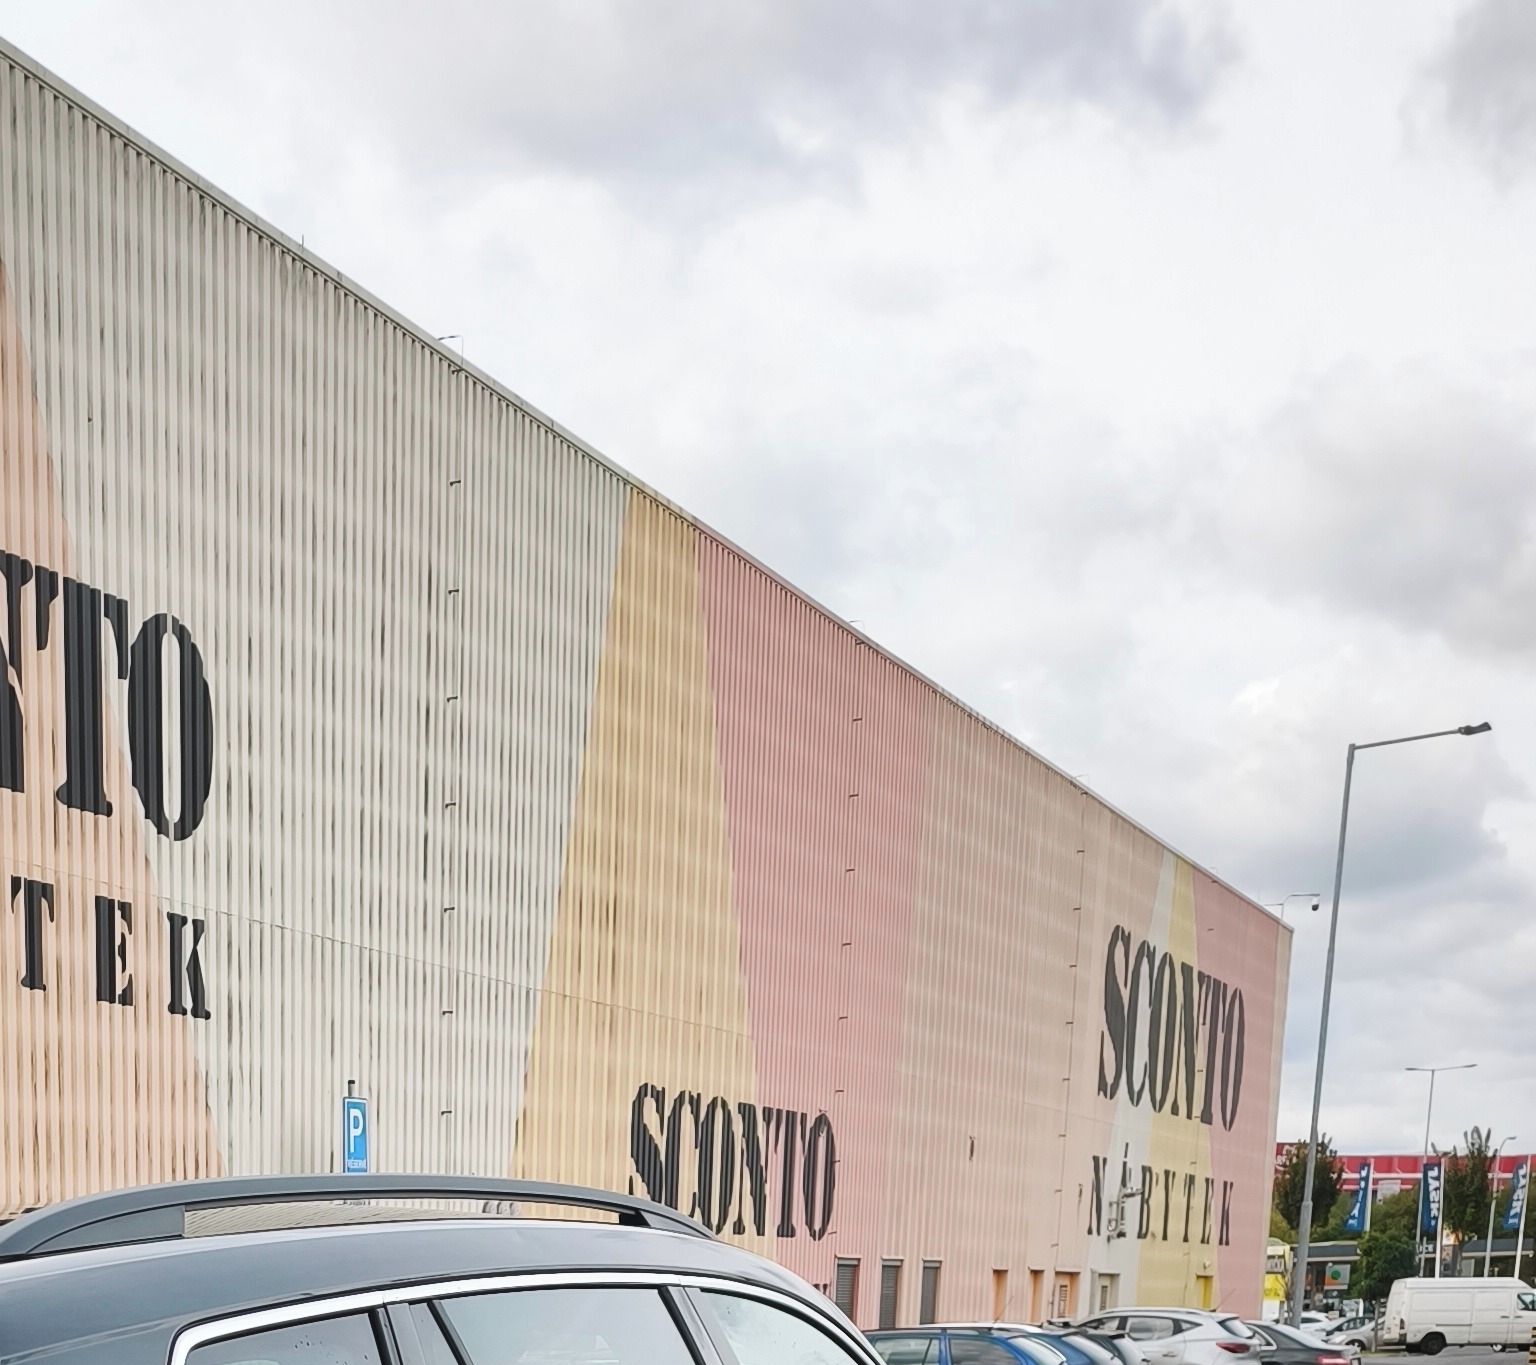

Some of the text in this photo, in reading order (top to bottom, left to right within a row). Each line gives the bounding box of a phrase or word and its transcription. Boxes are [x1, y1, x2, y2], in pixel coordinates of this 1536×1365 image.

[1098, 924, 1245, 1132] SCONTO
[349, 1108, 364, 1153] P
[629, 1082, 836, 1242] SCONTO
